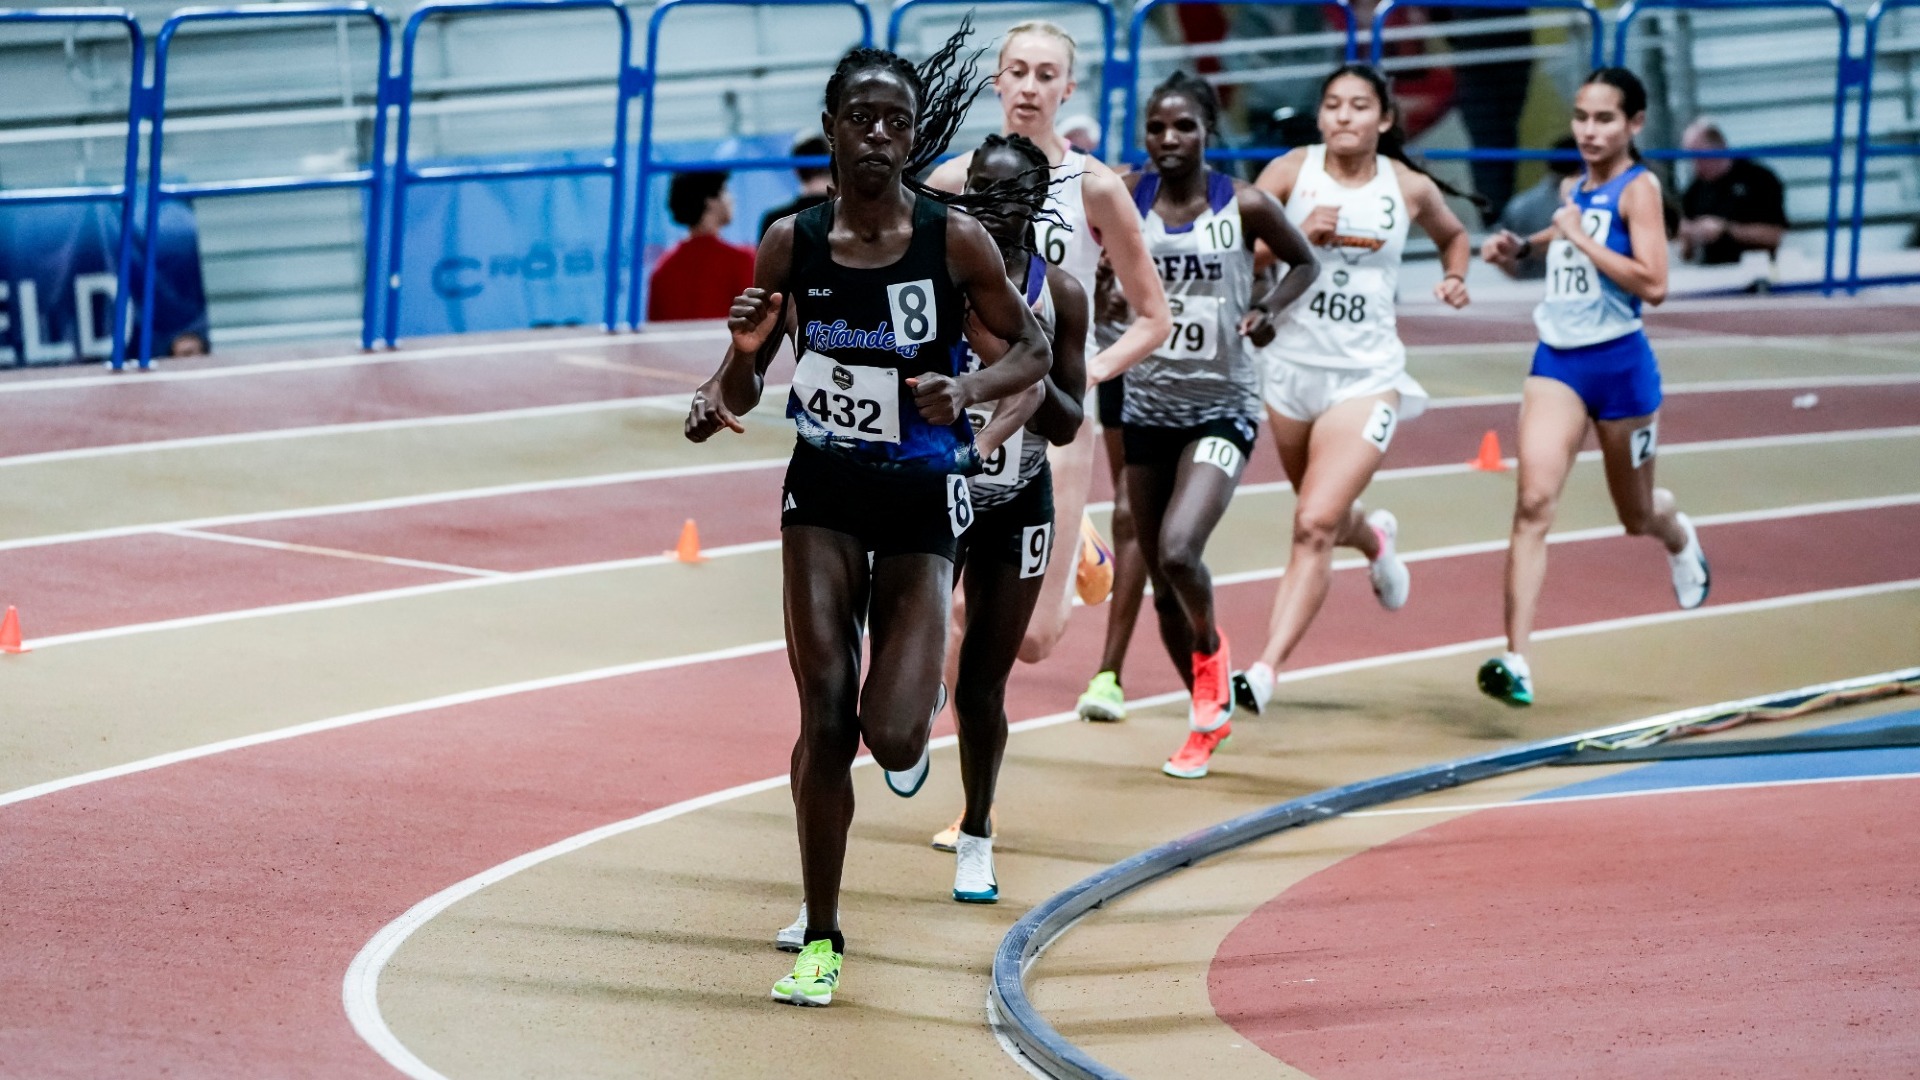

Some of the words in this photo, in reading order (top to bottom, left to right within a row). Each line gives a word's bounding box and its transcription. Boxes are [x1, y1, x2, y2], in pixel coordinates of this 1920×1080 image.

[1380, 195, 1395, 230] 3
[1044, 224, 1066, 266] 6
[1205, 219, 1235, 250] 10
[1554, 266, 1590, 294] 178
[898, 284, 930, 341] 8
[1309, 290, 1367, 323] 468
[807, 388, 883, 434] 432
[1371, 408, 1393, 443] 3
[983, 443, 1007, 476] 9
[1206, 440, 1234, 468] 10
[1638, 429, 1652, 460] 2
[953, 478, 971, 528] 8
[1027, 527, 1046, 574] 9
